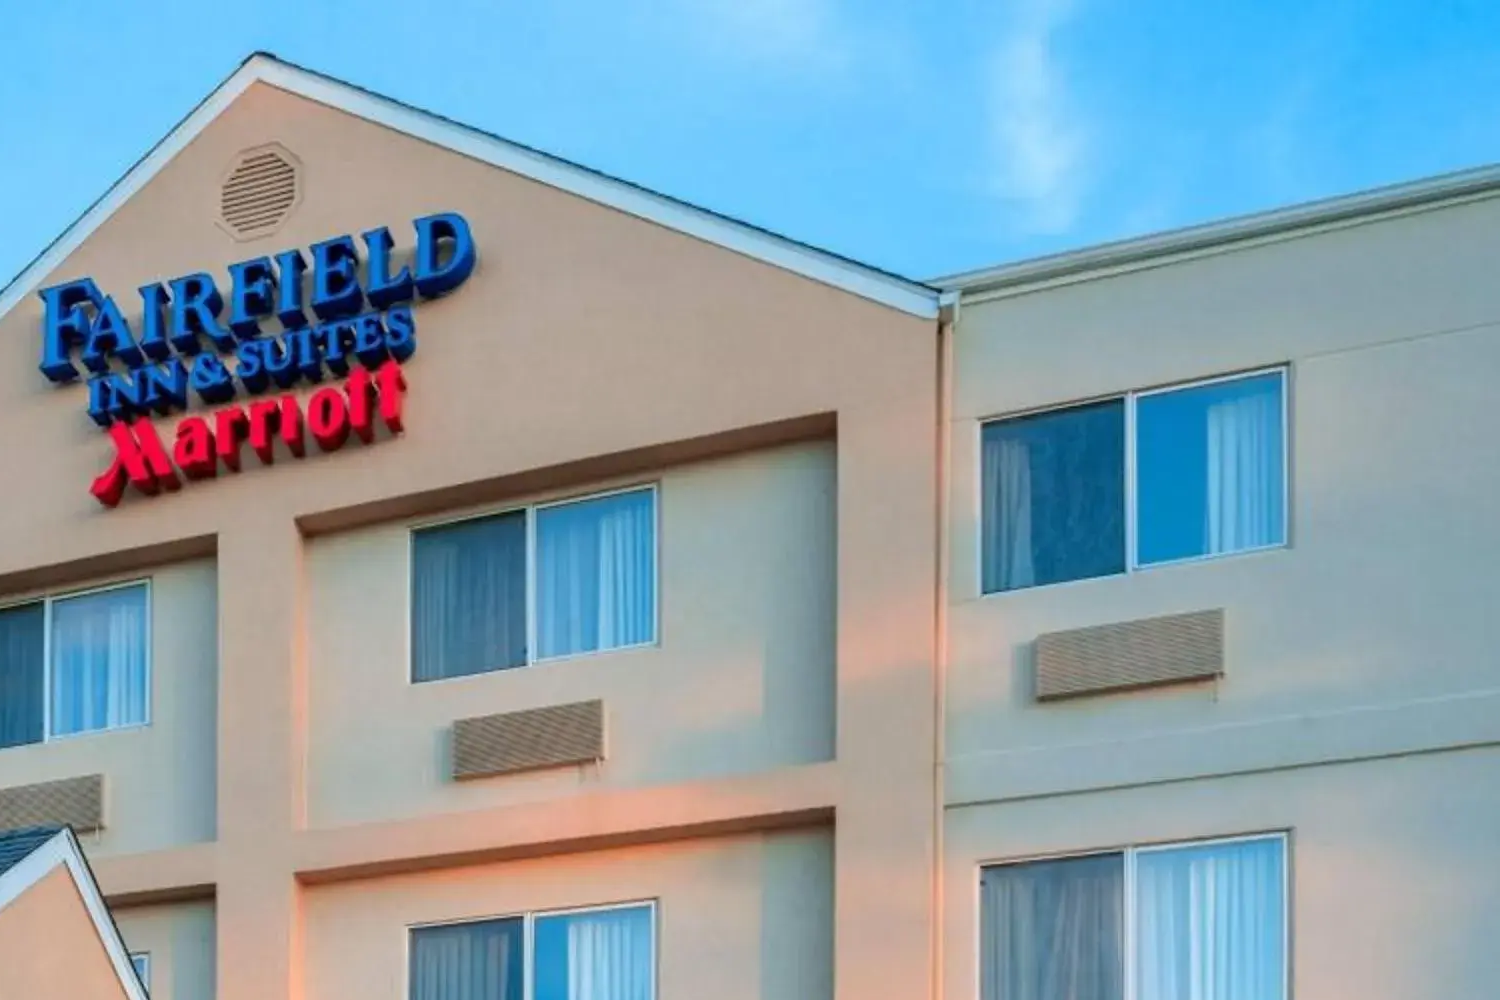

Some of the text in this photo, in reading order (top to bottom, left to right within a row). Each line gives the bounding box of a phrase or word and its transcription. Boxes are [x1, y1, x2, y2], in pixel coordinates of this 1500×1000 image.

[39, 211, 476, 381] FAIRFIELD
[88, 307, 416, 423] INN & SUITES
[90, 361, 406, 507] Marriott
